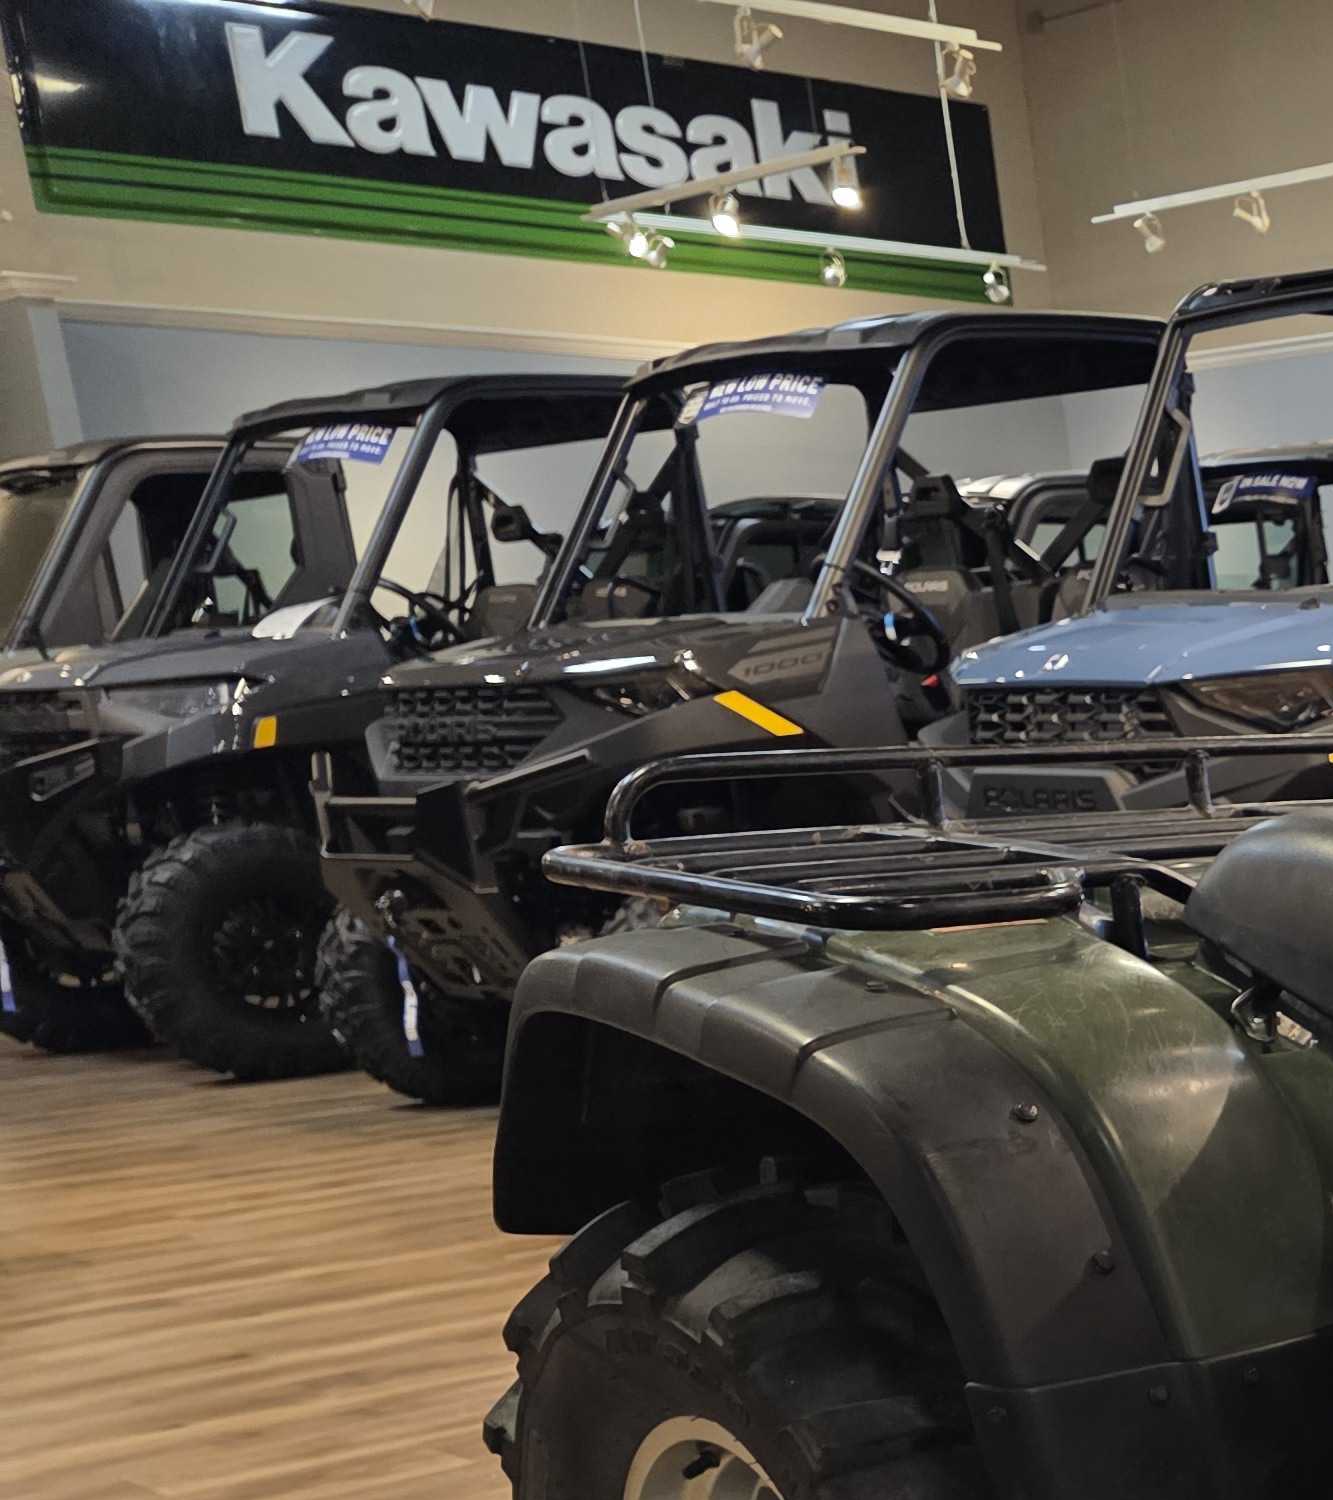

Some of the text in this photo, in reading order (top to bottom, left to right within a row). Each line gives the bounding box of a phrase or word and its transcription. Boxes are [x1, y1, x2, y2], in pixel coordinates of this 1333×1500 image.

[225, 22, 852, 206] Kawasaki
[768, 374, 823, 395] PRICE
[347, 423, 393, 446] PRICE
[743, 651, 824, 678] 1000
